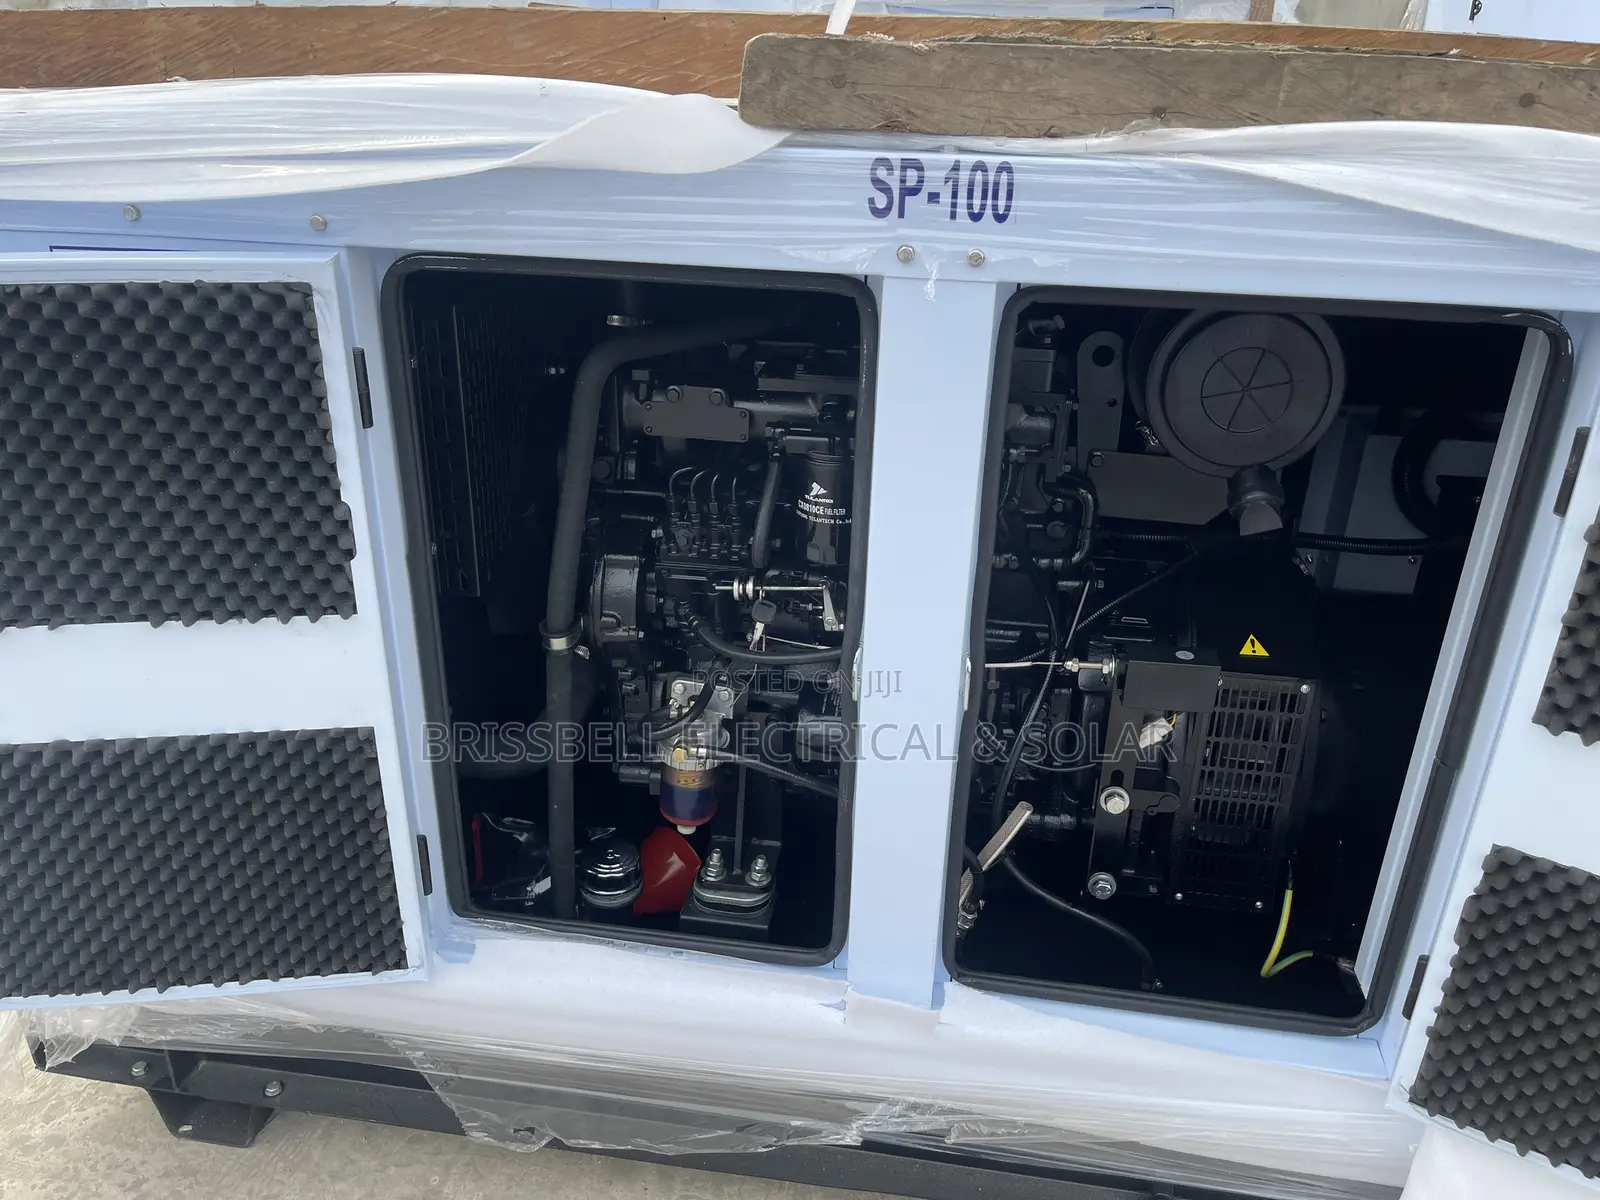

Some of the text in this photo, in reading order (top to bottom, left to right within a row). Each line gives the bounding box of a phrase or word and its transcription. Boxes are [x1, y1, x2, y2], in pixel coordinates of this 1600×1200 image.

[868, 157, 1014, 224] SP-100
[824, 508, 833, 516] FUEL
[834, 508, 846, 516] FILTER
